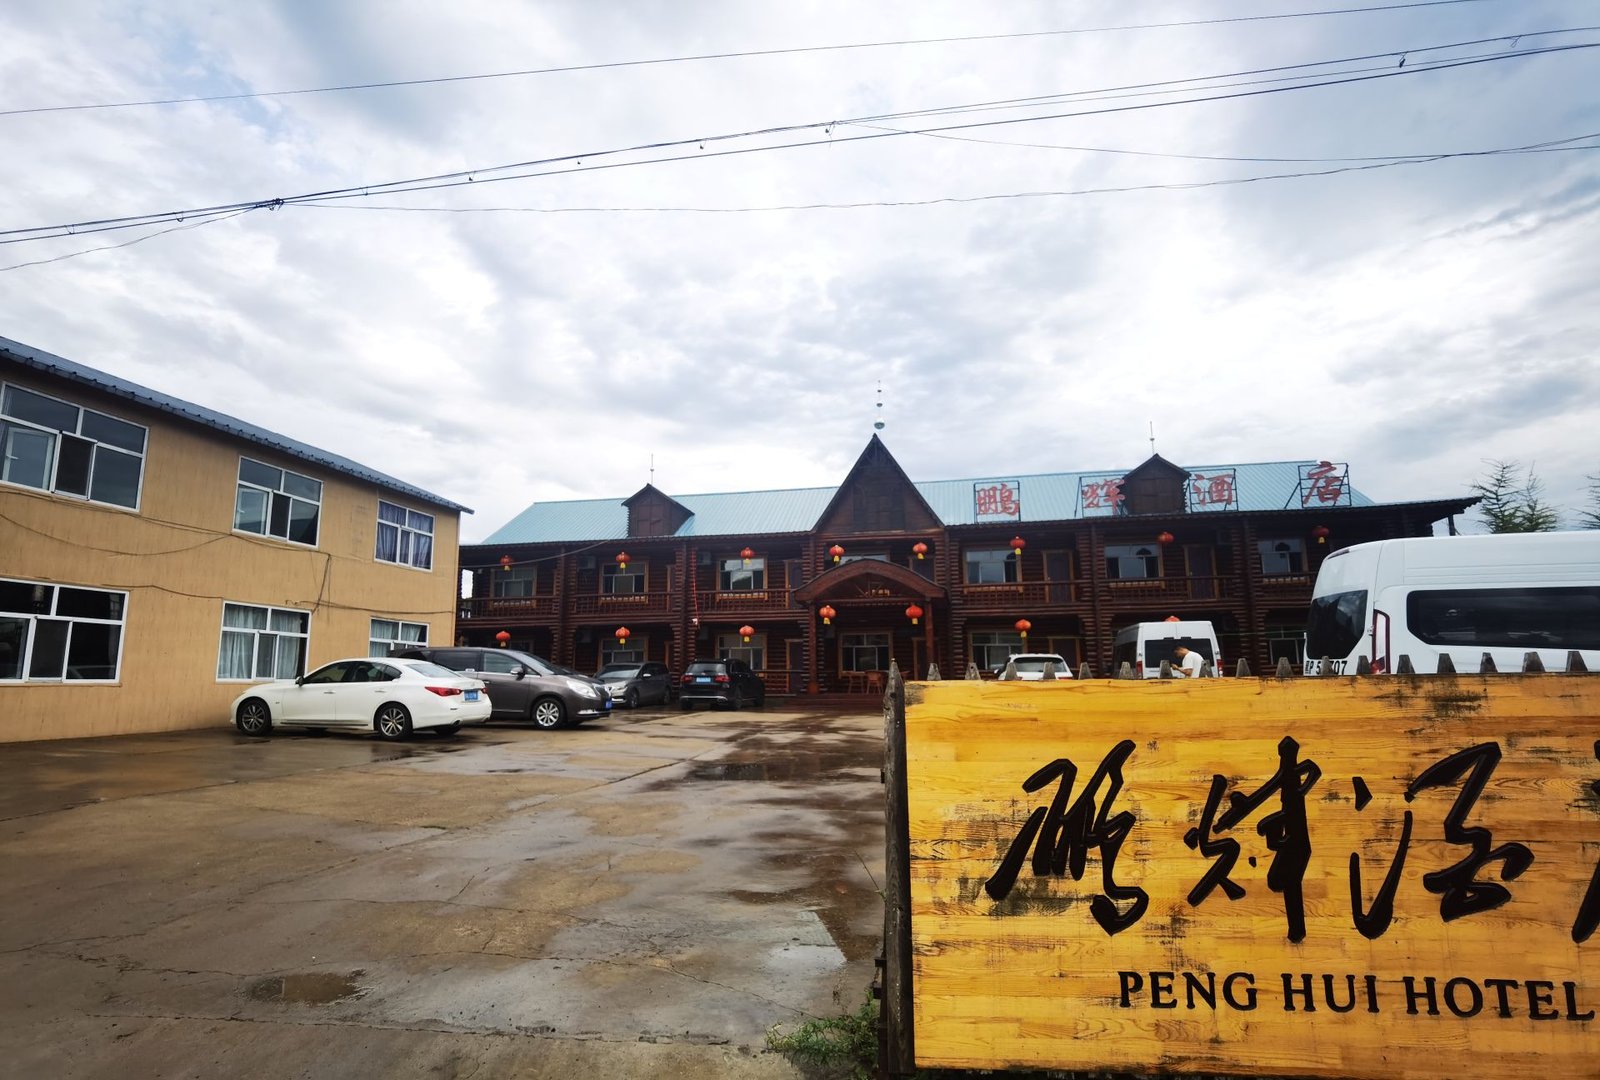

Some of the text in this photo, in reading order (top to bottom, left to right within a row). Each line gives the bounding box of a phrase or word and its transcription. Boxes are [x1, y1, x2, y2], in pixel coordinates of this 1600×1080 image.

[984, 735, 1600, 944] 鹏辉酒
[1118, 971, 1596, 1021] PENG HUI HOTEL
